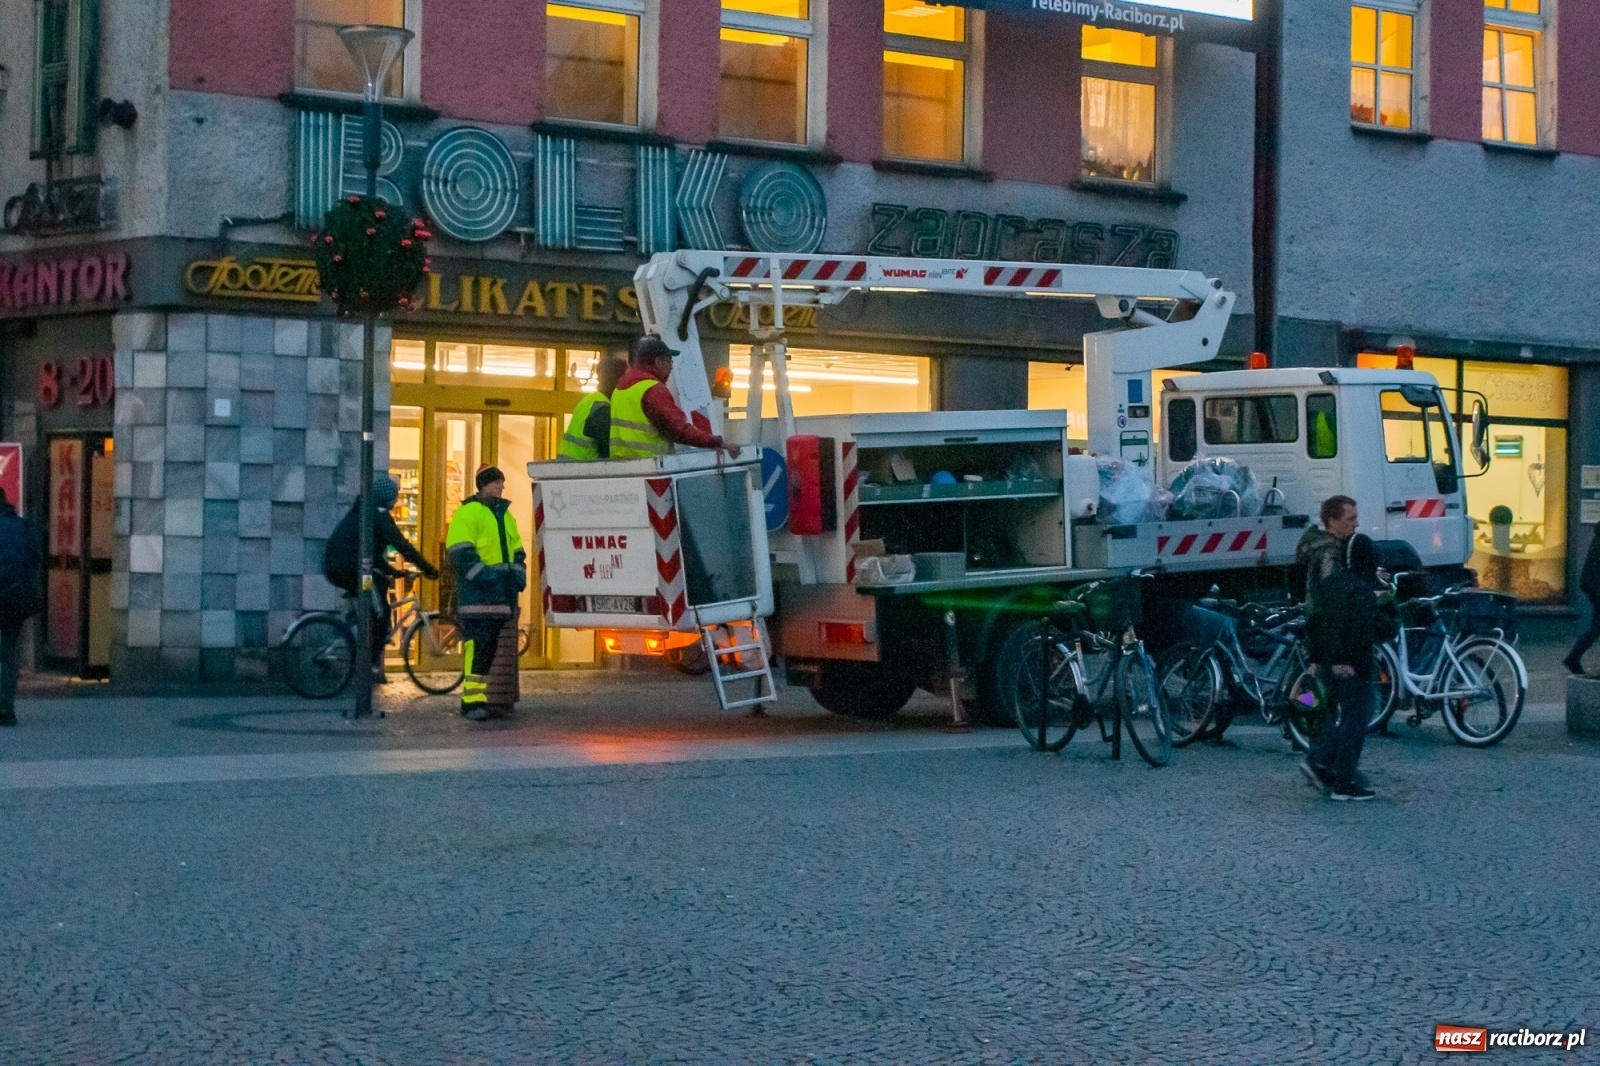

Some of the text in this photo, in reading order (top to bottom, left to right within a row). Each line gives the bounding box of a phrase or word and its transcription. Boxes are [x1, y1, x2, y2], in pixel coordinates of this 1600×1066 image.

[882, 268, 927, 278] WUMAG
[424, 271, 644, 324] LIKATES
[571, 535, 628, 549] WUMAG
